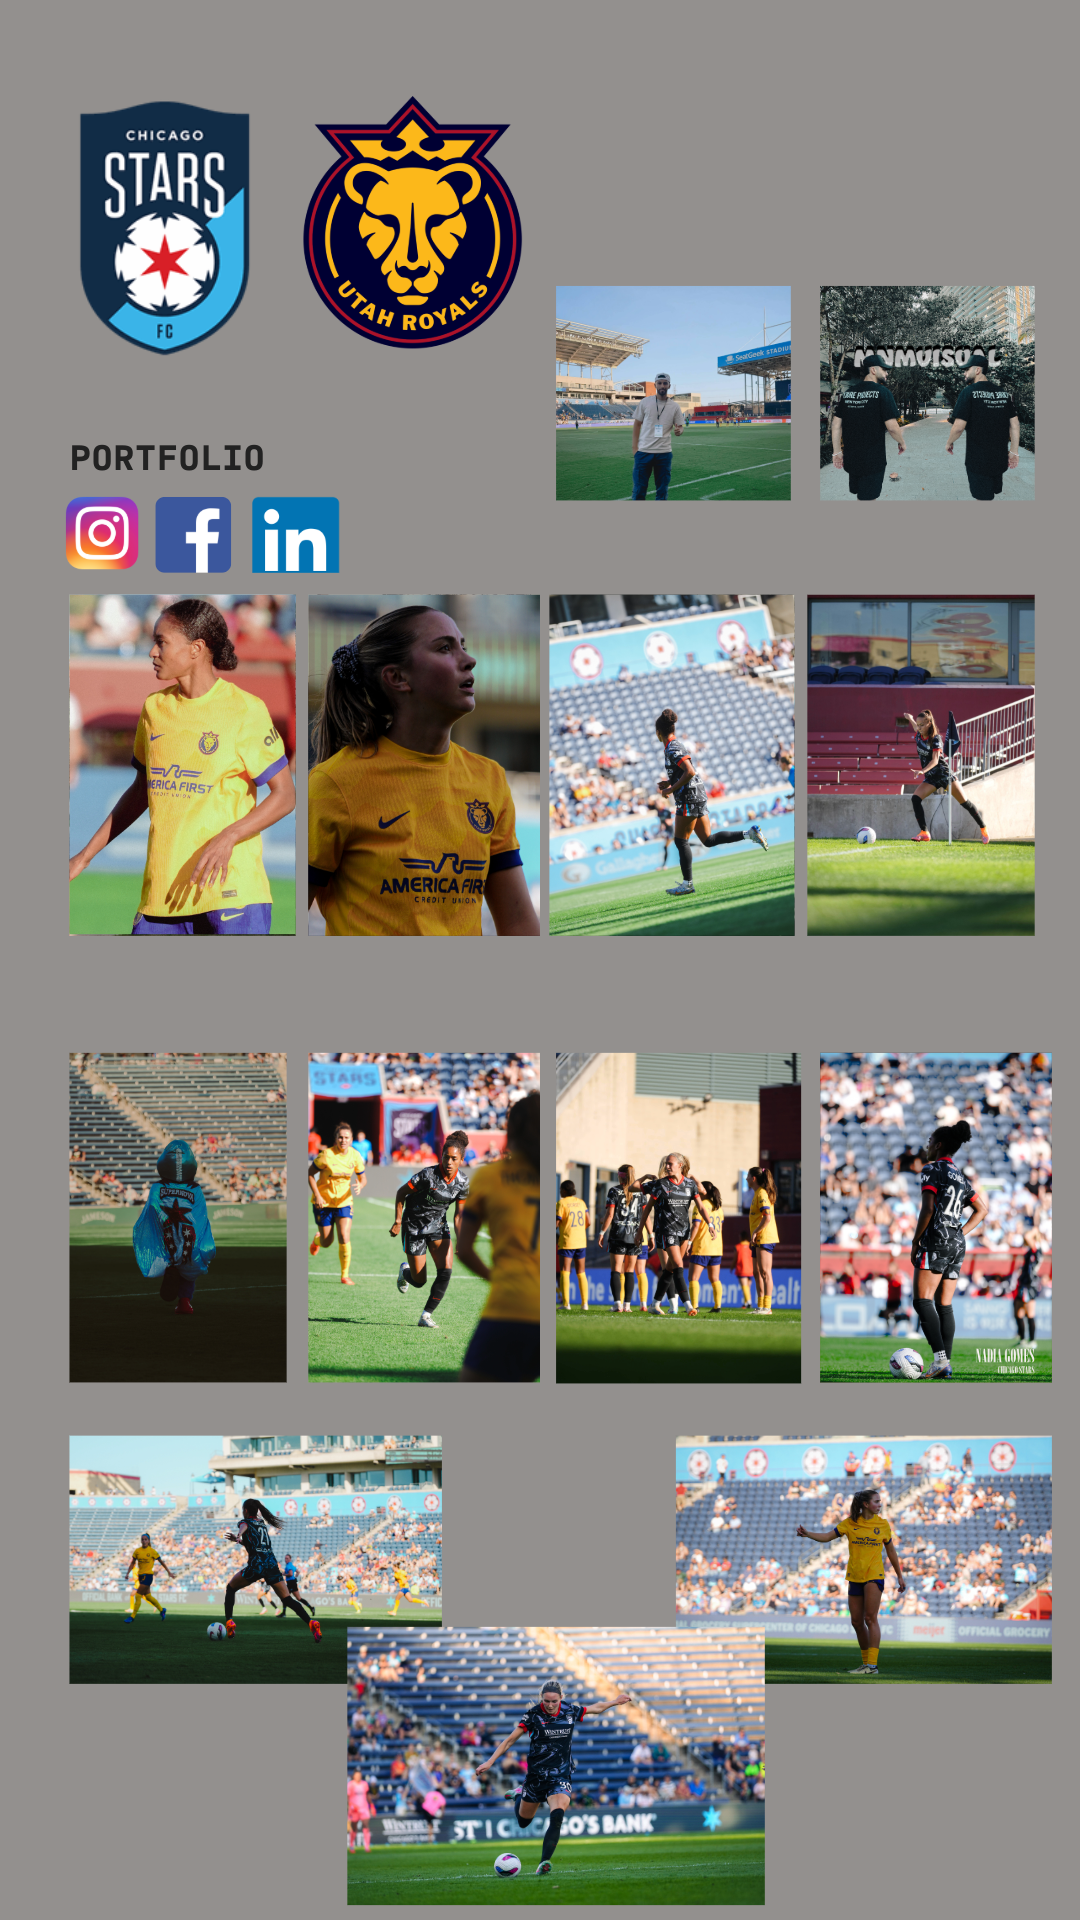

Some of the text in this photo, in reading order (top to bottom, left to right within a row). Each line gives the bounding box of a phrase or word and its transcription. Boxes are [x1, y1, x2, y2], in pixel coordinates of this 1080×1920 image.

[735, 350, 765, 362] SeatGeek
[179, 782, 214, 794] FIRST
[380, 877, 459, 895] AMERICA
[414, 896, 446, 904] CREDIT
[314, 1070, 376, 1087] STARS
[160, 1188, 194, 1202] SUPERNOVA
[621, 1197, 639, 1217] 34
[944, 1185, 964, 1219] 26
[81, 1211, 116, 1224] JAMESON
[212, 1208, 244, 1219] JAMESON
[569, 1210, 585, 1227] 28
[587, 1275, 605, 1301] he
[258, 1527, 269, 1546] 21
[82, 1592, 105, 1602] OFFICIAL
[107, 1592, 122, 1602] BANK
[159, 1592, 177, 1602] STARS
[795, 1623, 807, 1633] OF
[808, 1623, 849, 1634] CHICAGO
[913, 1625, 945, 1637] meijer
[958, 1626, 1050, 1638] OFFICIAL GROCERY
[560, 1781, 573, 1793] 30
[602, 1813, 656, 1834] BANK
